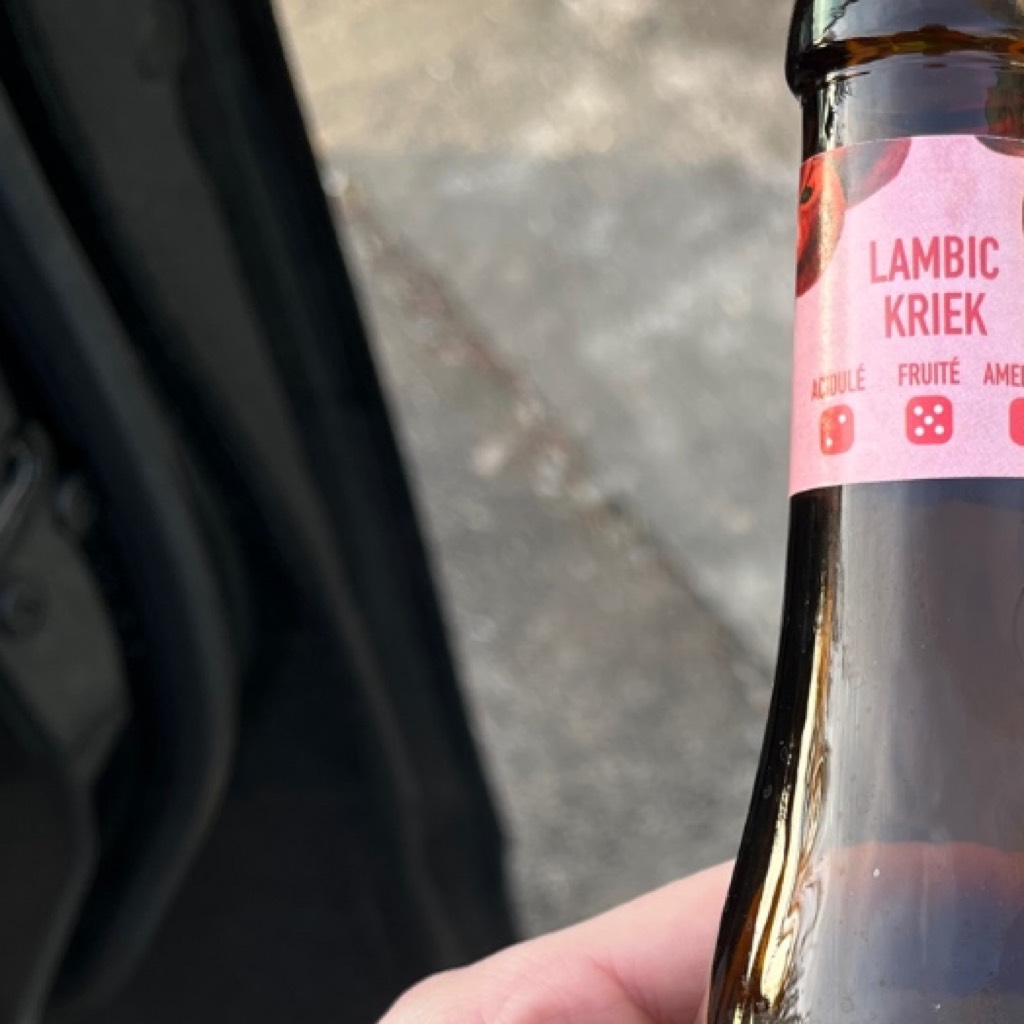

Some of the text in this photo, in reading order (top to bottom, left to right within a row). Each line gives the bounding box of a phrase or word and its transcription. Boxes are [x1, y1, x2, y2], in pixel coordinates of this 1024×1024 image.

[870, 235, 1000, 283] LAMBIC
[884, 292, 988, 338] KRIEK
[811, 363, 866, 400] ACIDULÉ
[899, 356, 961, 386] FRUITÉ
